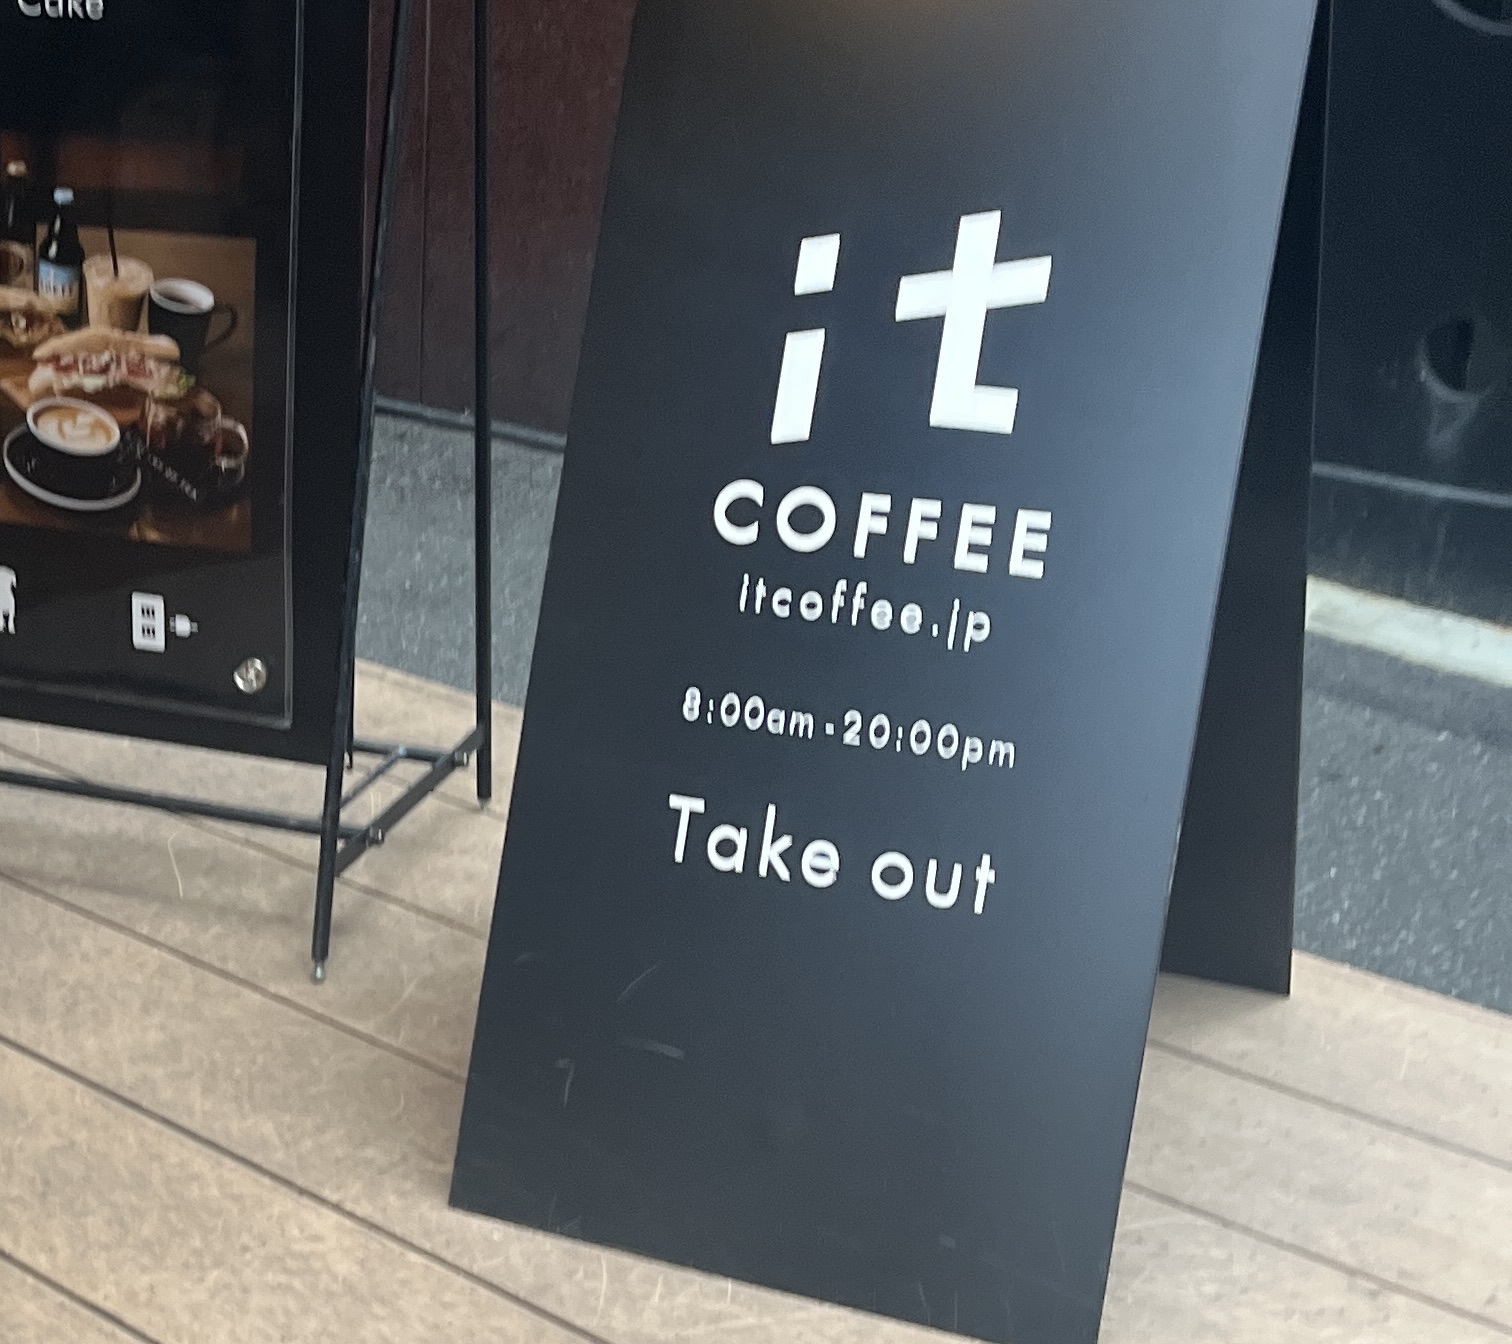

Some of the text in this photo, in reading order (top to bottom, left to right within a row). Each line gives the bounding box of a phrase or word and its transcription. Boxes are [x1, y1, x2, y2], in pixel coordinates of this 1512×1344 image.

[769, 209, 1053, 446] it
[713, 478, 1053, 580] COFFEE
[738, 572, 992, 653] itcoffee.jp
[668, 793, 997, 916] Take out
